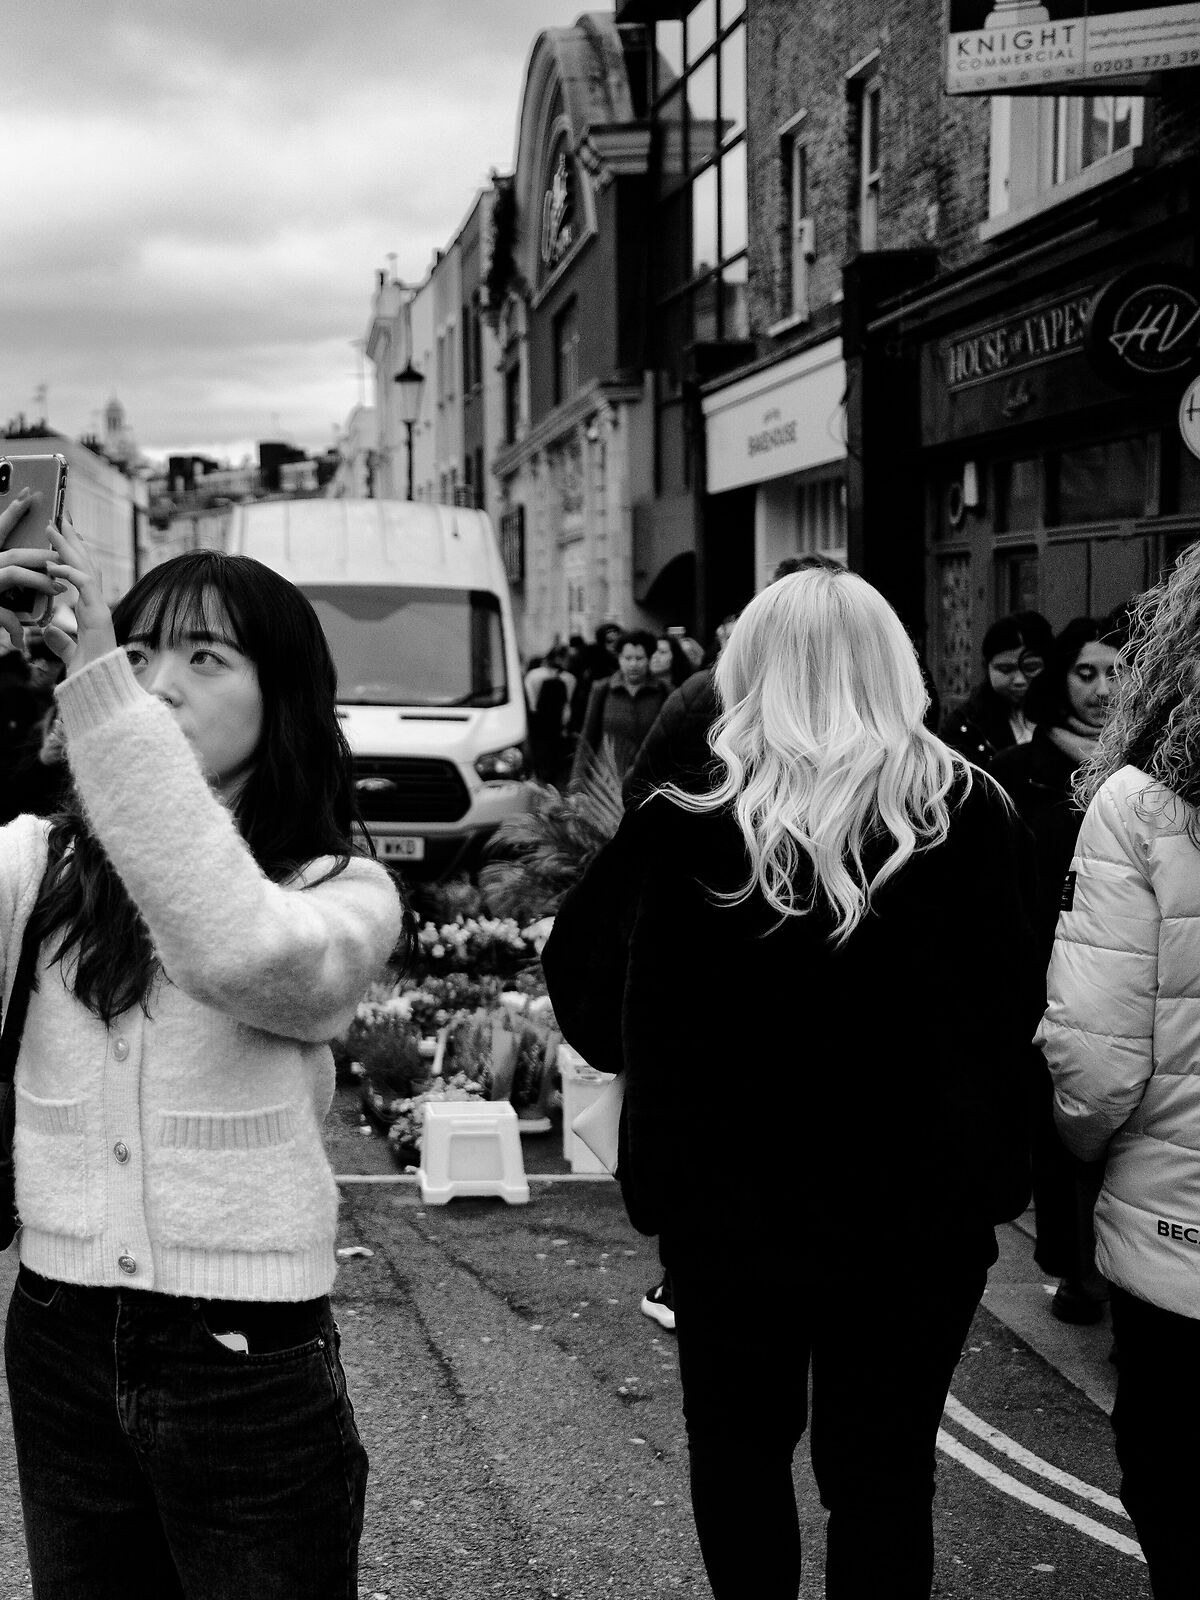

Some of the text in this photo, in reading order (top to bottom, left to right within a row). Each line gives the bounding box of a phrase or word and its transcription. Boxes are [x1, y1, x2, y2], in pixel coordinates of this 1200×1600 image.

[956, 25, 1076, 56] KNIGHT
[955, 49, 1074, 71] COMMERCIAL
[1093, 58, 1133, 73] 0203
[1142, 54, 1171, 68] 773
[956, 68, 1076, 89] LONDON
[949, 328, 1009, 384] HOUSE
[1157, 1219, 1200, 1245] BEC
